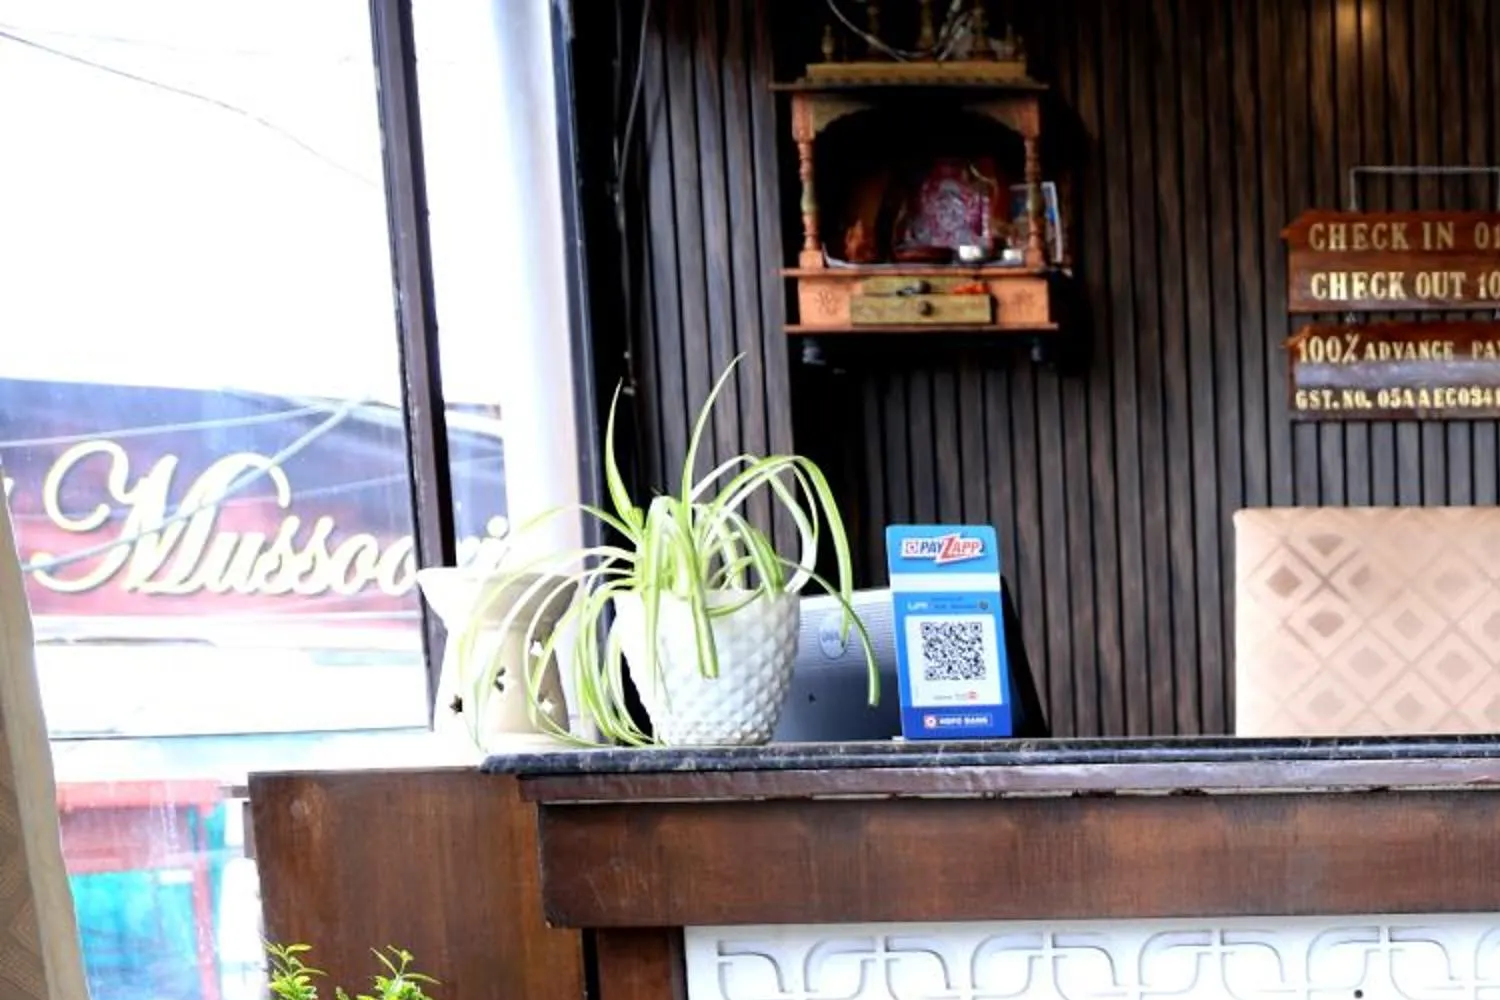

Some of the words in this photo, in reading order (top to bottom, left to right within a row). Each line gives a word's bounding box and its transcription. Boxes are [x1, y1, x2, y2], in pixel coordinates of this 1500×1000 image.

[1308, 222, 1408, 251] CHECK
[1422, 221, 1455, 250] IN
[1310, 271, 1407, 300] CHECK
[1415, 271, 1466, 299] OUT
[1300, 334, 1360, 364] 100%
[1364, 340, 1455, 361] ADVANCE
